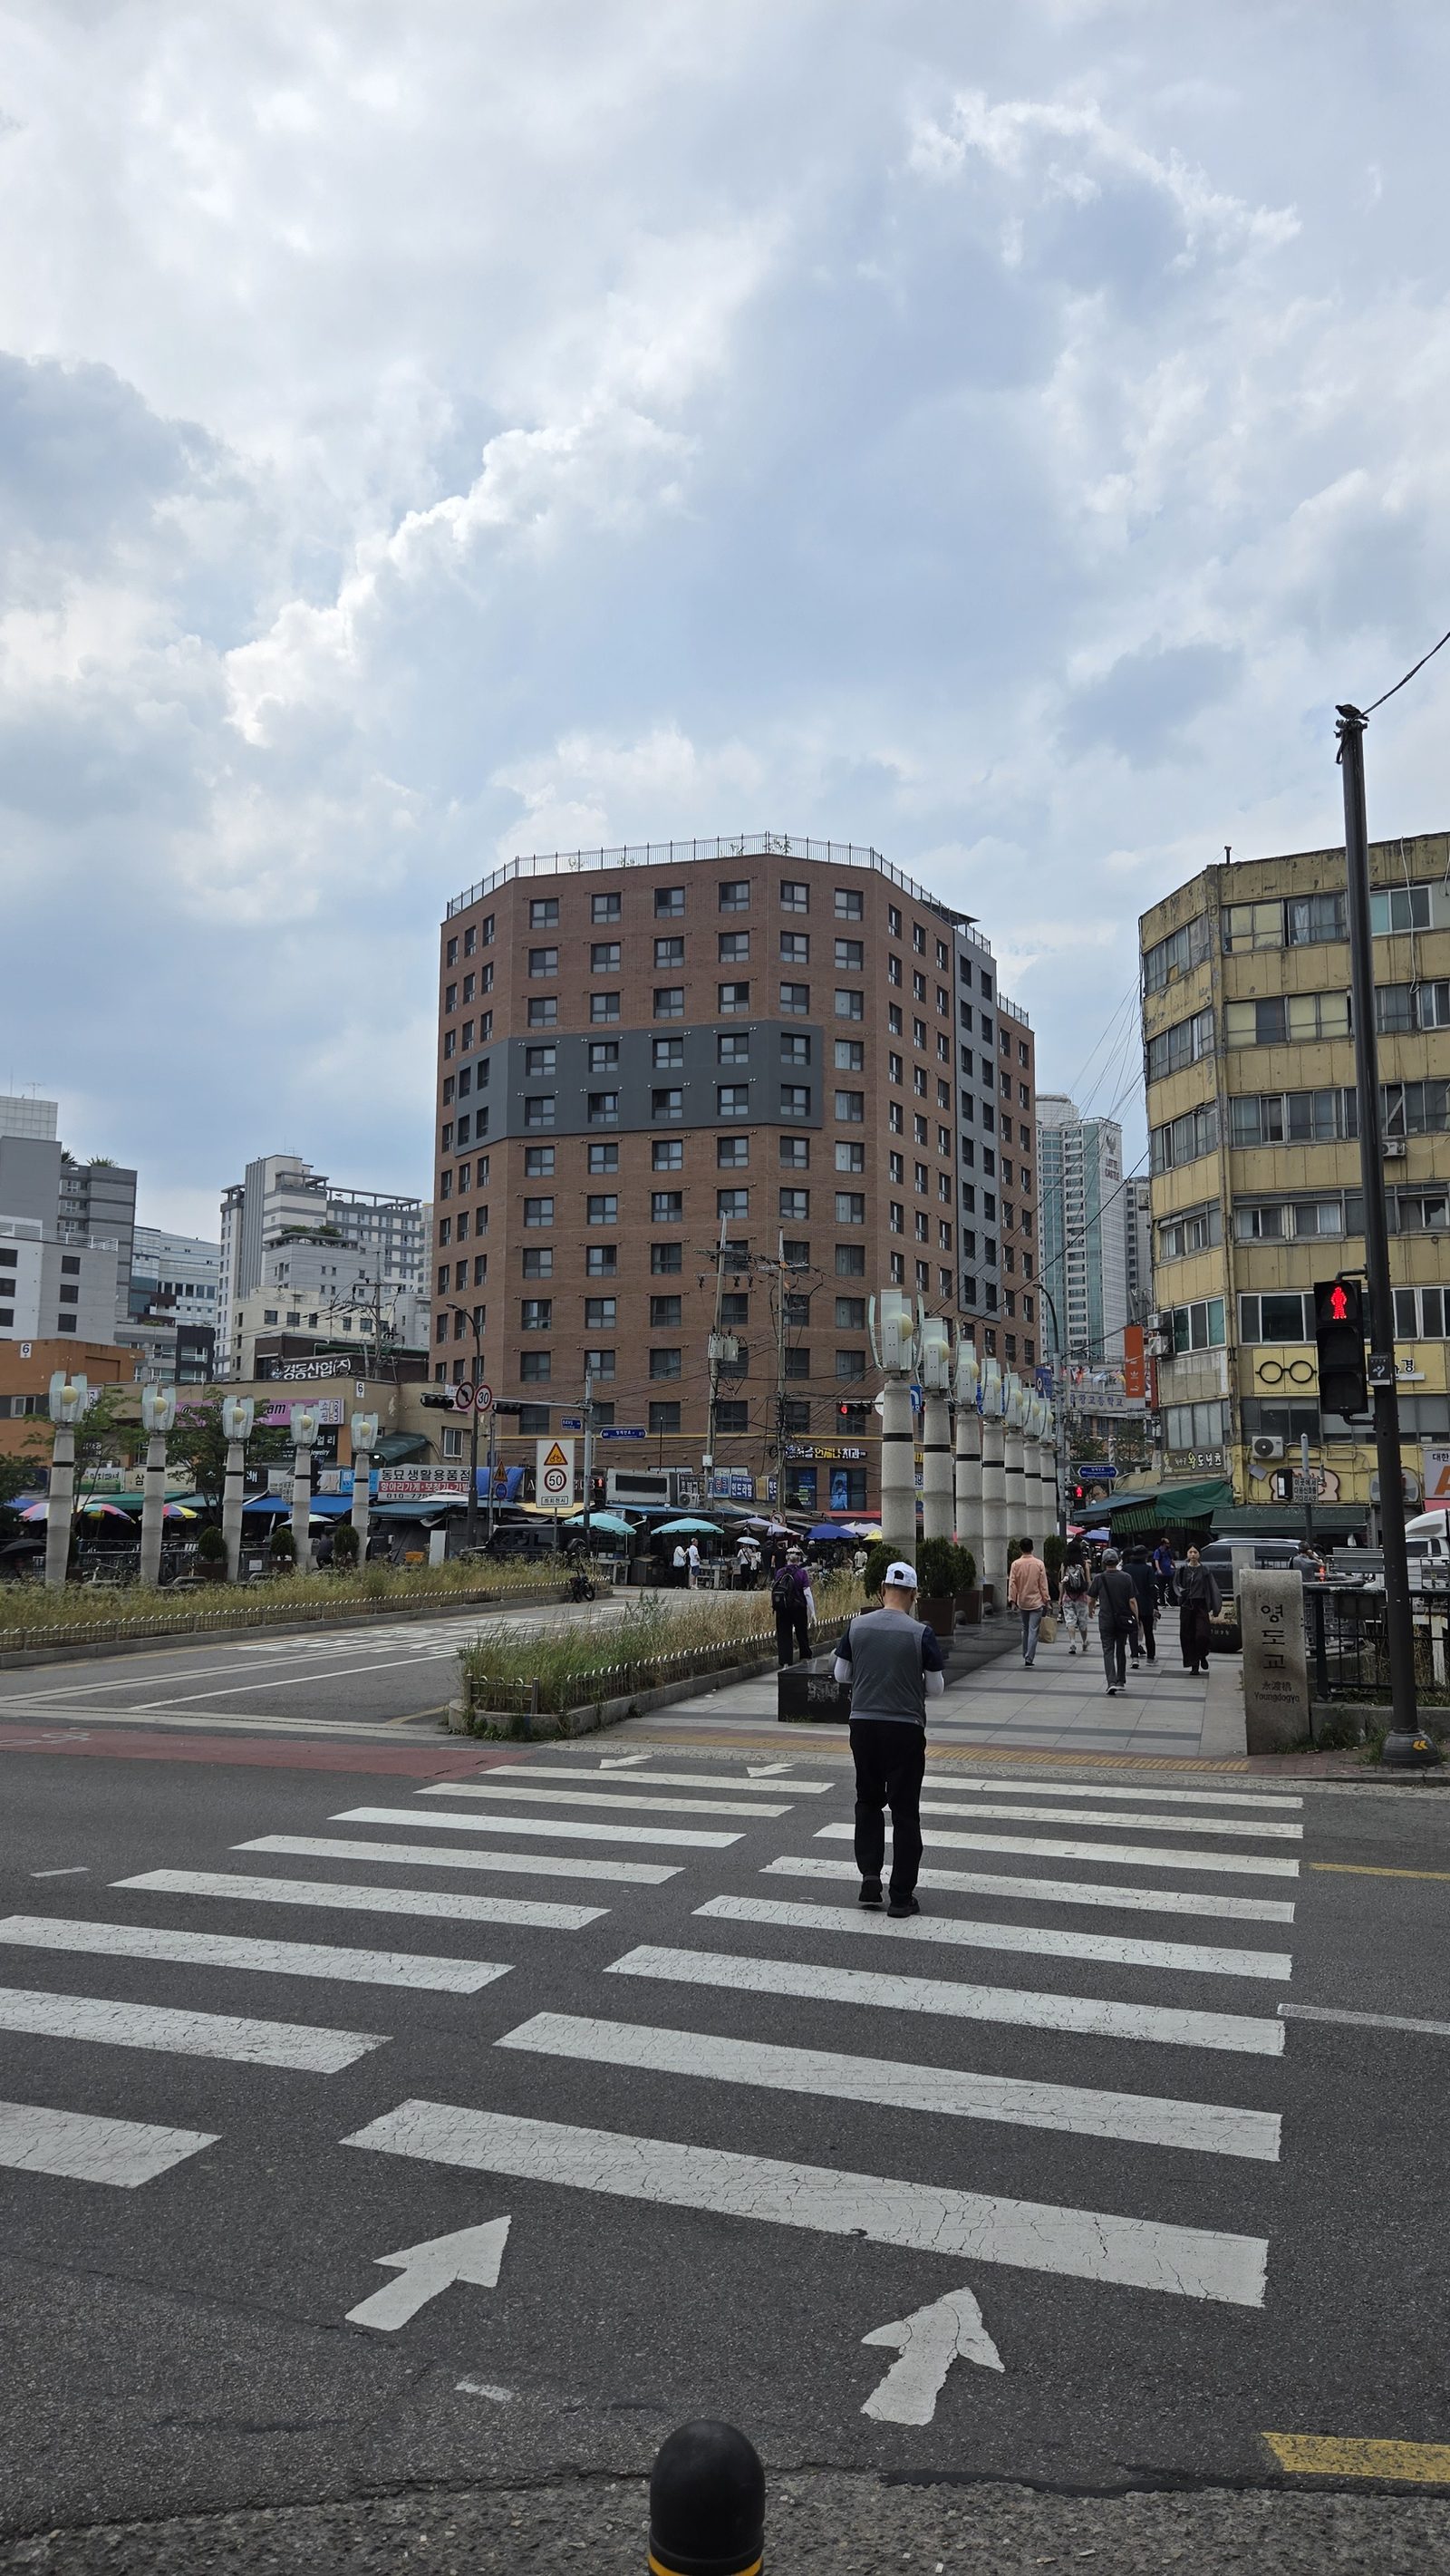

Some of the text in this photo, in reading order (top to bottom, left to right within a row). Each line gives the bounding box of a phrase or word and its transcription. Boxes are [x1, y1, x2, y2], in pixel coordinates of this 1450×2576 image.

[23, 1344, 30, 1354] 6
[358, 1383, 363, 1393] 6
[478, 1391, 489, 1403] 30
[842, 1447, 860, 1459] 치과
[549, 1476, 562, 1486] 50
[1261, 1604, 1286, 1669] 영도교
